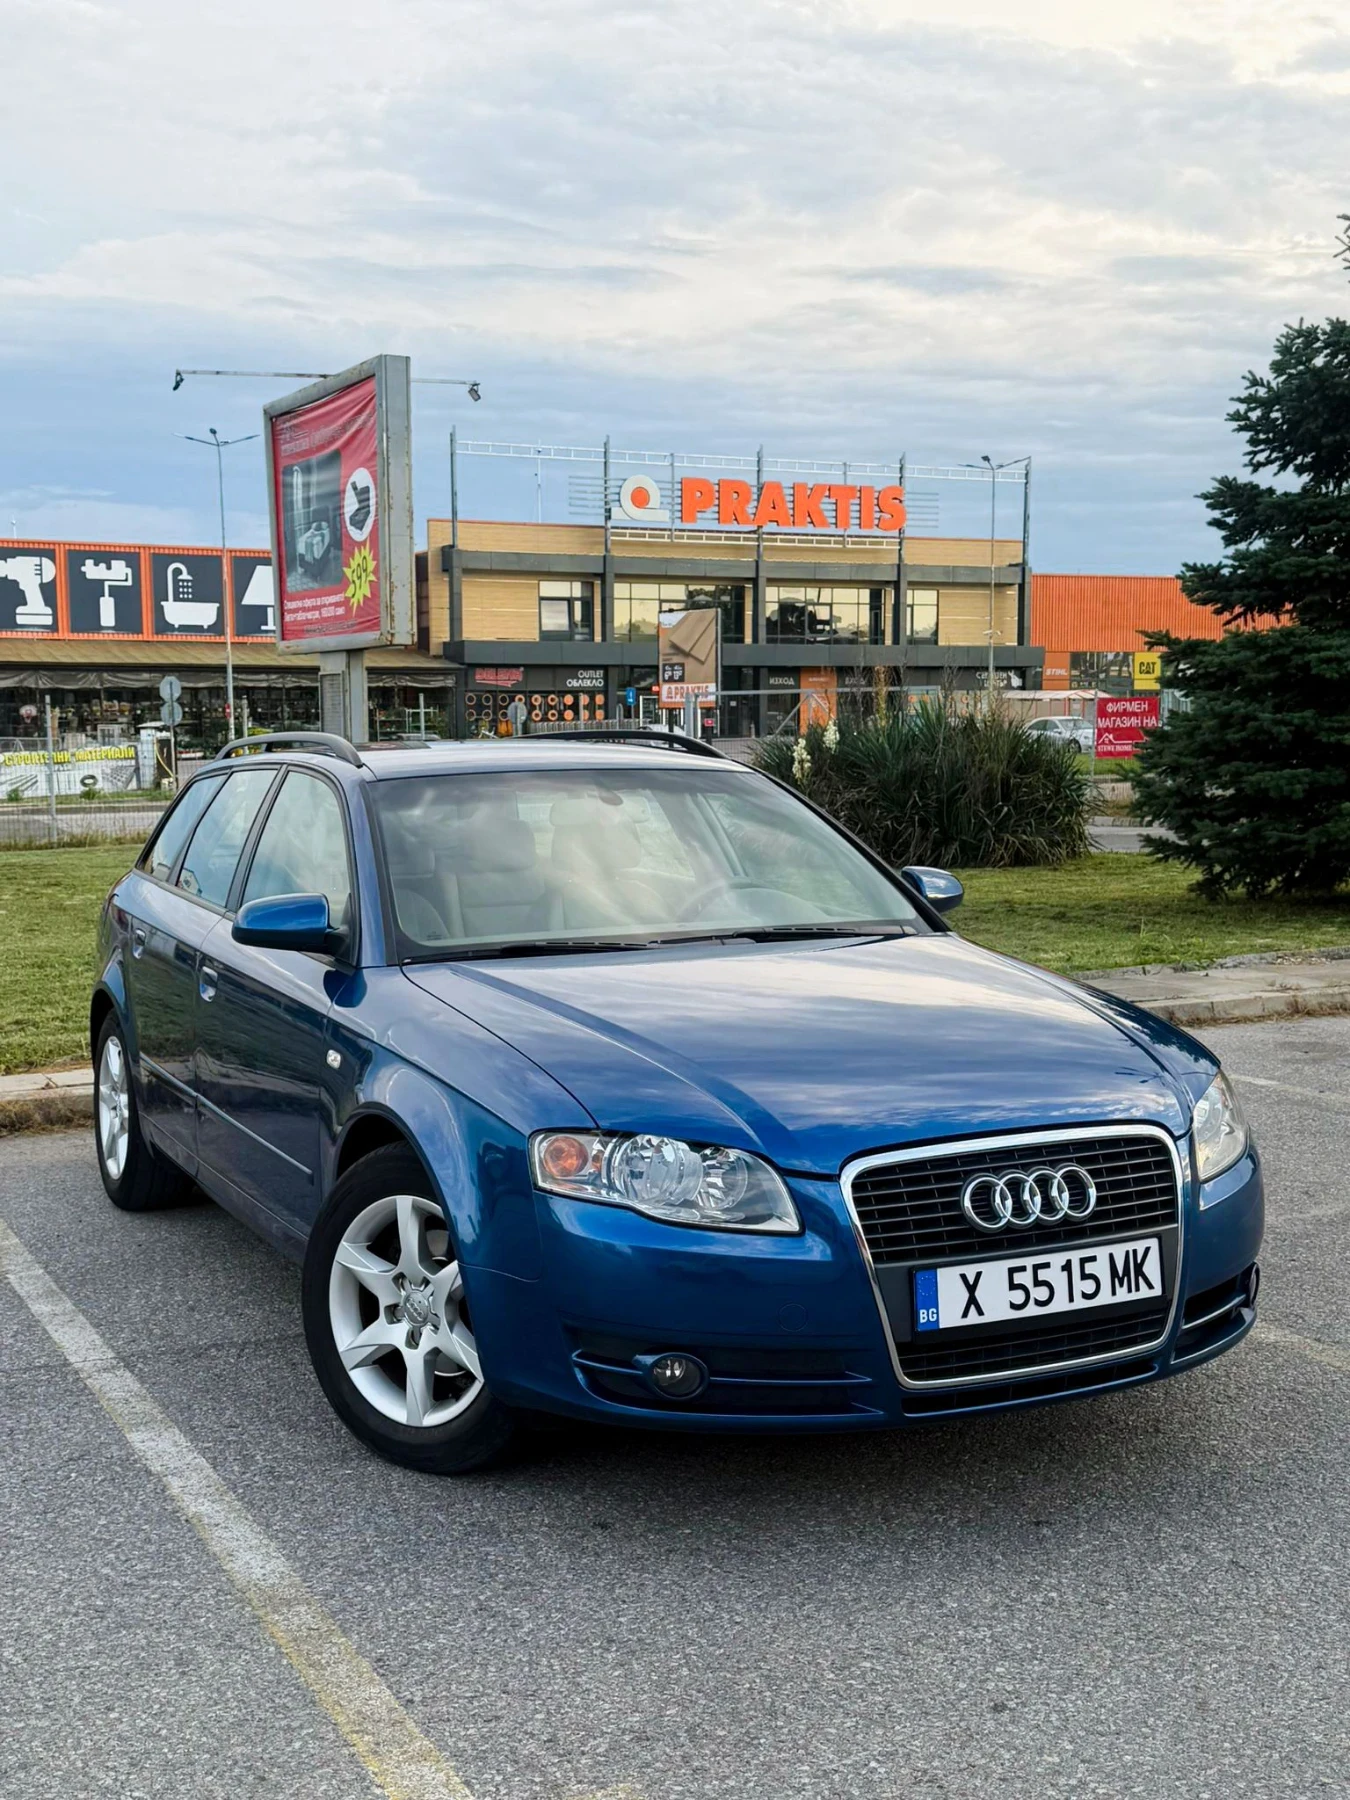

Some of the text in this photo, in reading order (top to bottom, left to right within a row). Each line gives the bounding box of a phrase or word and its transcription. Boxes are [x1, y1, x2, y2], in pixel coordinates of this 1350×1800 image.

[681, 477, 907, 532] PRAKTIS
[577, 670, 604, 678] OUTLET
[1045, 668, 1068, 676] STIHL
[1138, 661, 1157, 674] CAT
[566, 678, 604, 688] ОБЛЕКЛО
[769, 677, 795, 686] ИЗХОД
[1106, 701, 1149, 713] ФИРМЕН
[1097, 715, 1158, 729] МАГАЗИН НА
[74, 746, 135, 762] МАТЕРИАЛИ
[1007, 1255, 1102, 1311] 5515
[1108, 1246, 1156, 1297] MK
[919, 1308, 938, 1324] BG
